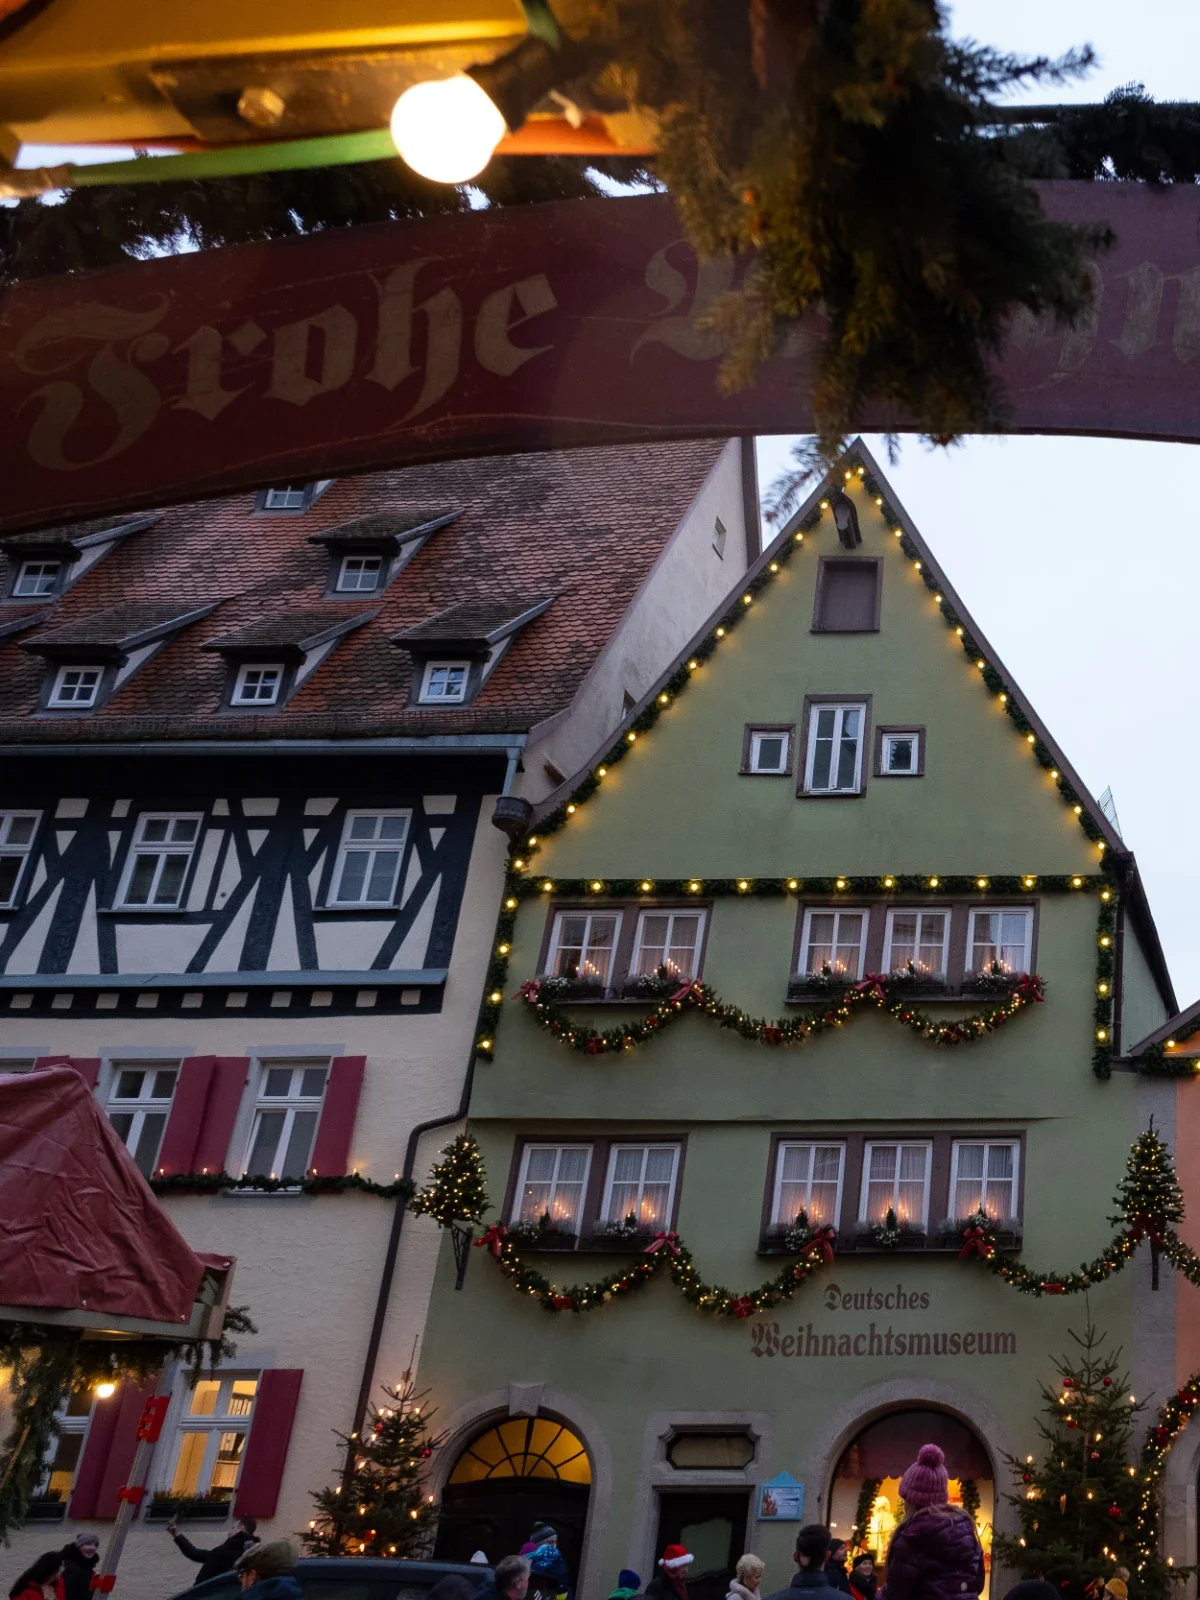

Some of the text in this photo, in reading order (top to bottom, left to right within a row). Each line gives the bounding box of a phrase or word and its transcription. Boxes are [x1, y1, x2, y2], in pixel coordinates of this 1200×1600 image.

[15, 255, 559, 471] Frohe
[823, 1282, 930, 1312] Deutsches
[750, 1321, 1018, 1359] Weihnachtsmuseum
